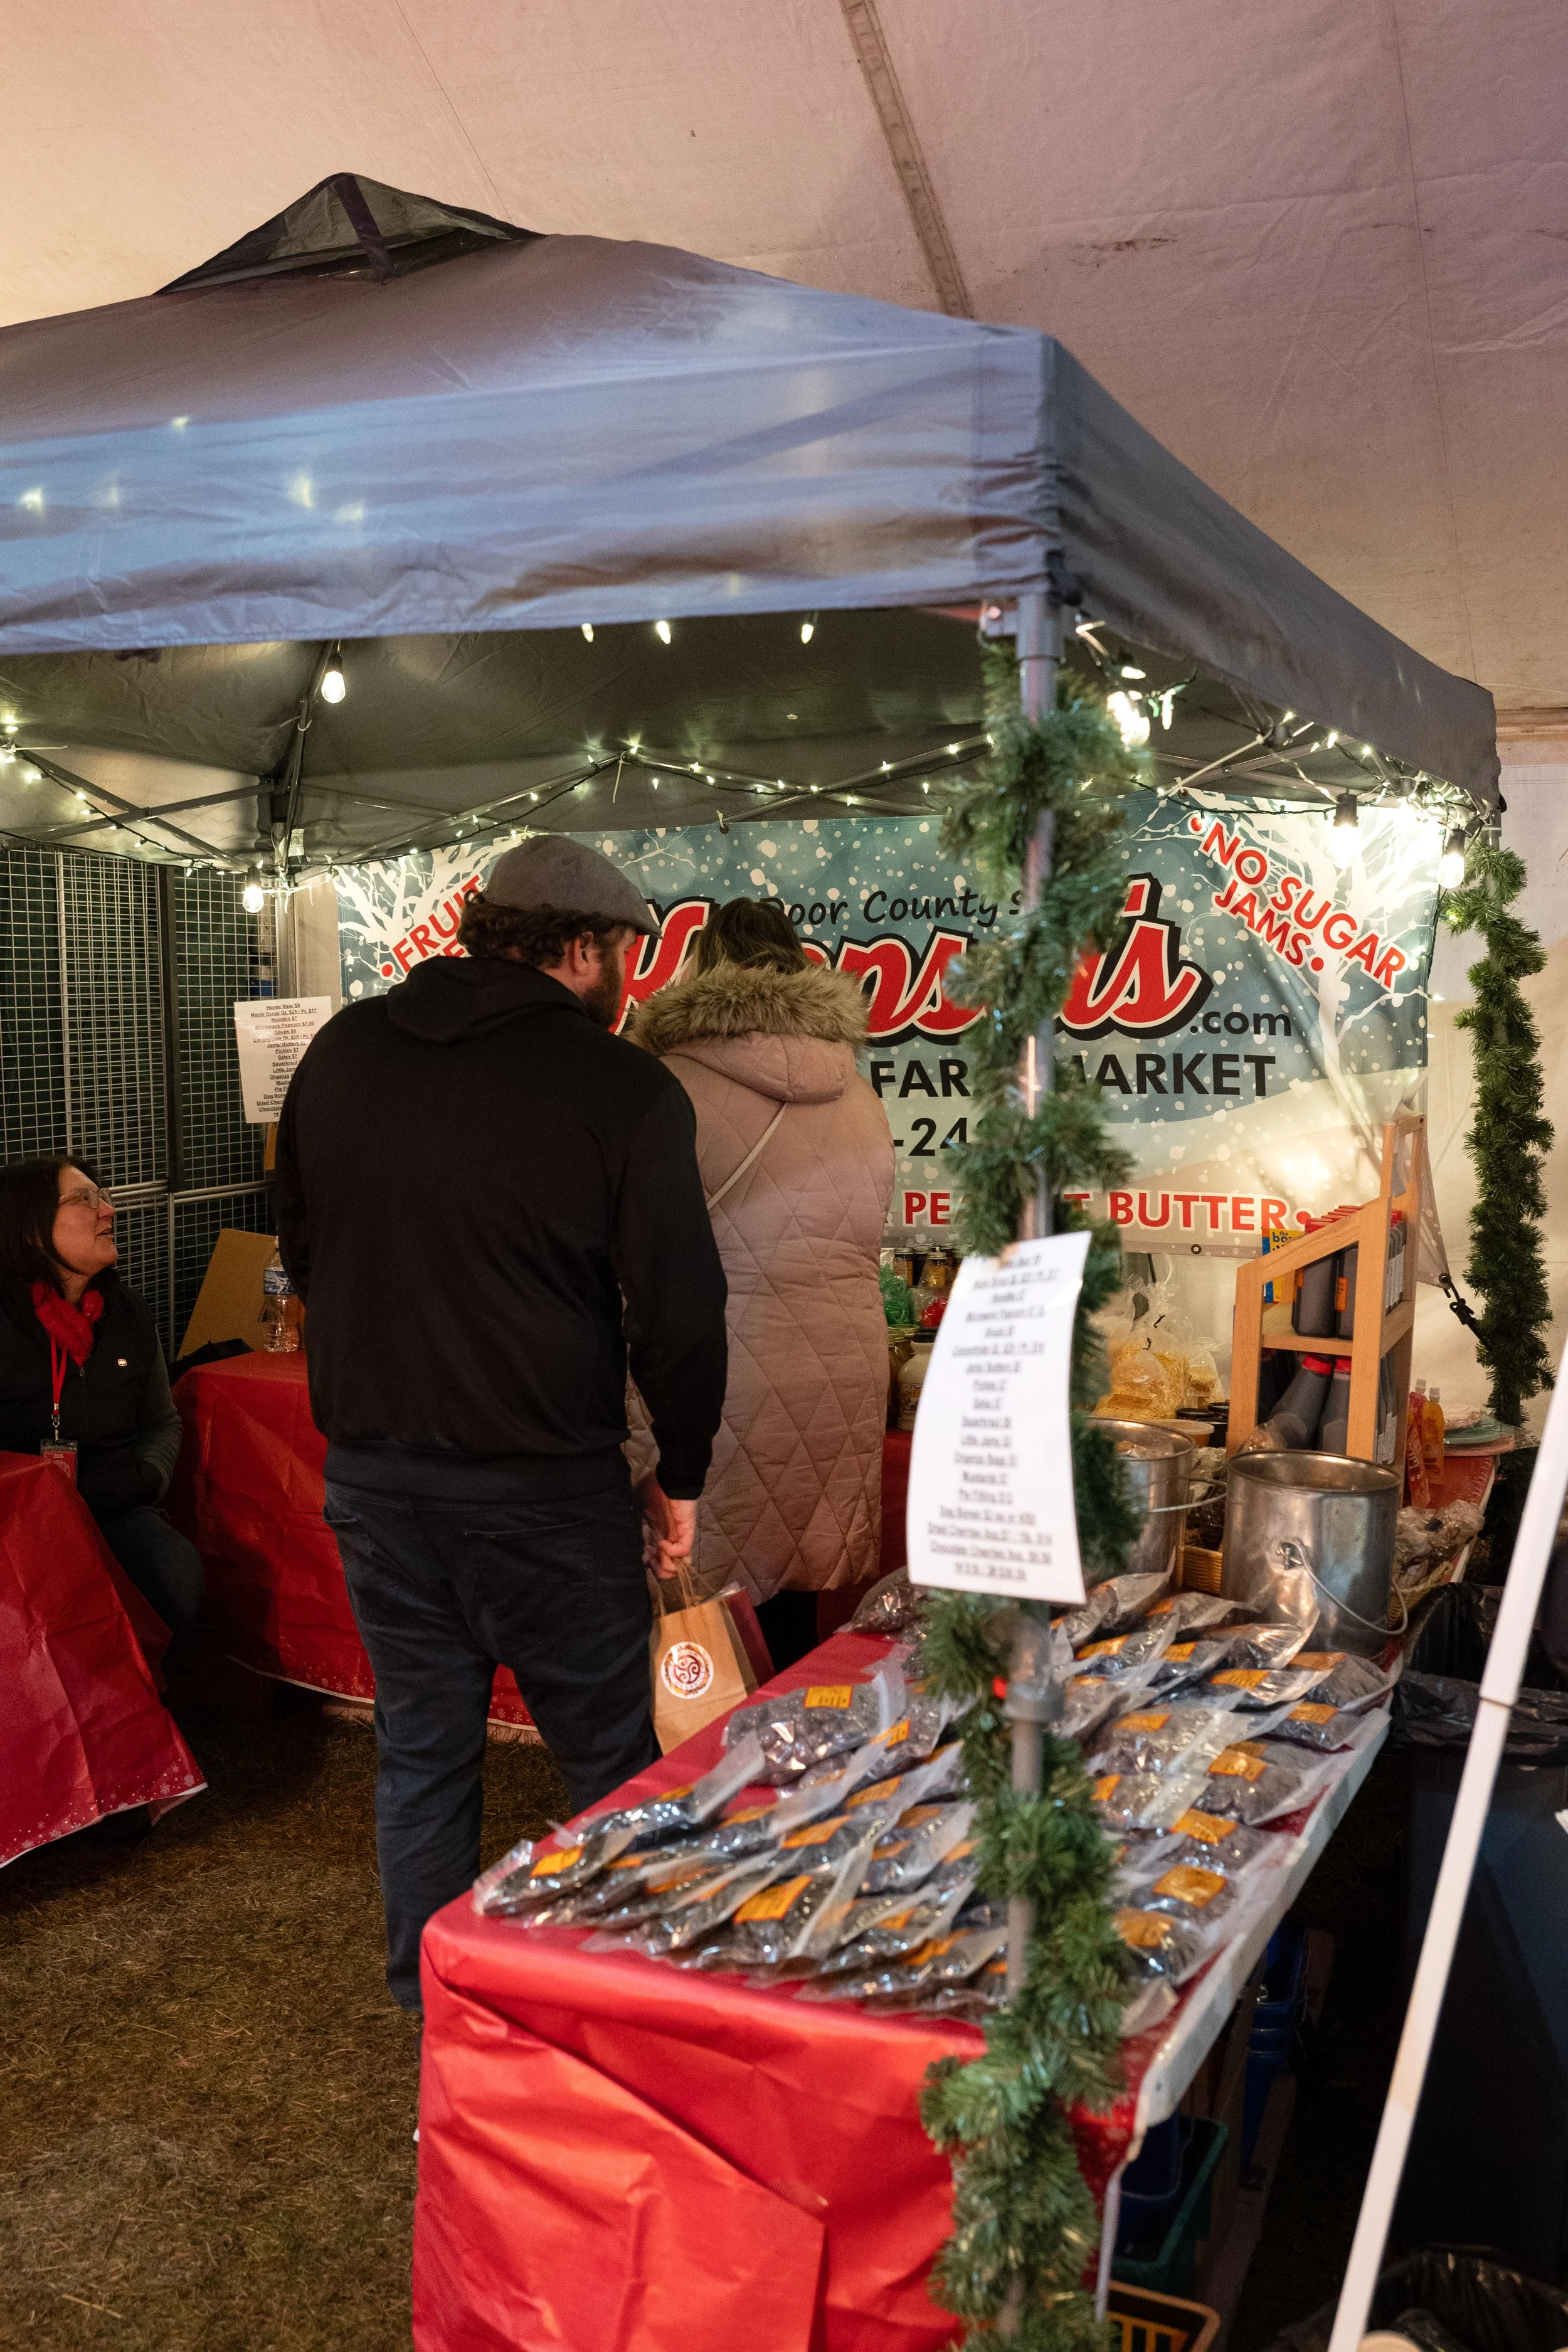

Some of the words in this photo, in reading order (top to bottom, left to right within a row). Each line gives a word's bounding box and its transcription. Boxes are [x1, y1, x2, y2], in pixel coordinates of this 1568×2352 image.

[863, 887, 999, 928] County
[1203, 823, 1267, 885] NO
[1271, 877, 1406, 988] SUGAR
[1214, 880, 1311, 965] JAMS
[1110, 1192, 1287, 1231] BUTTER
